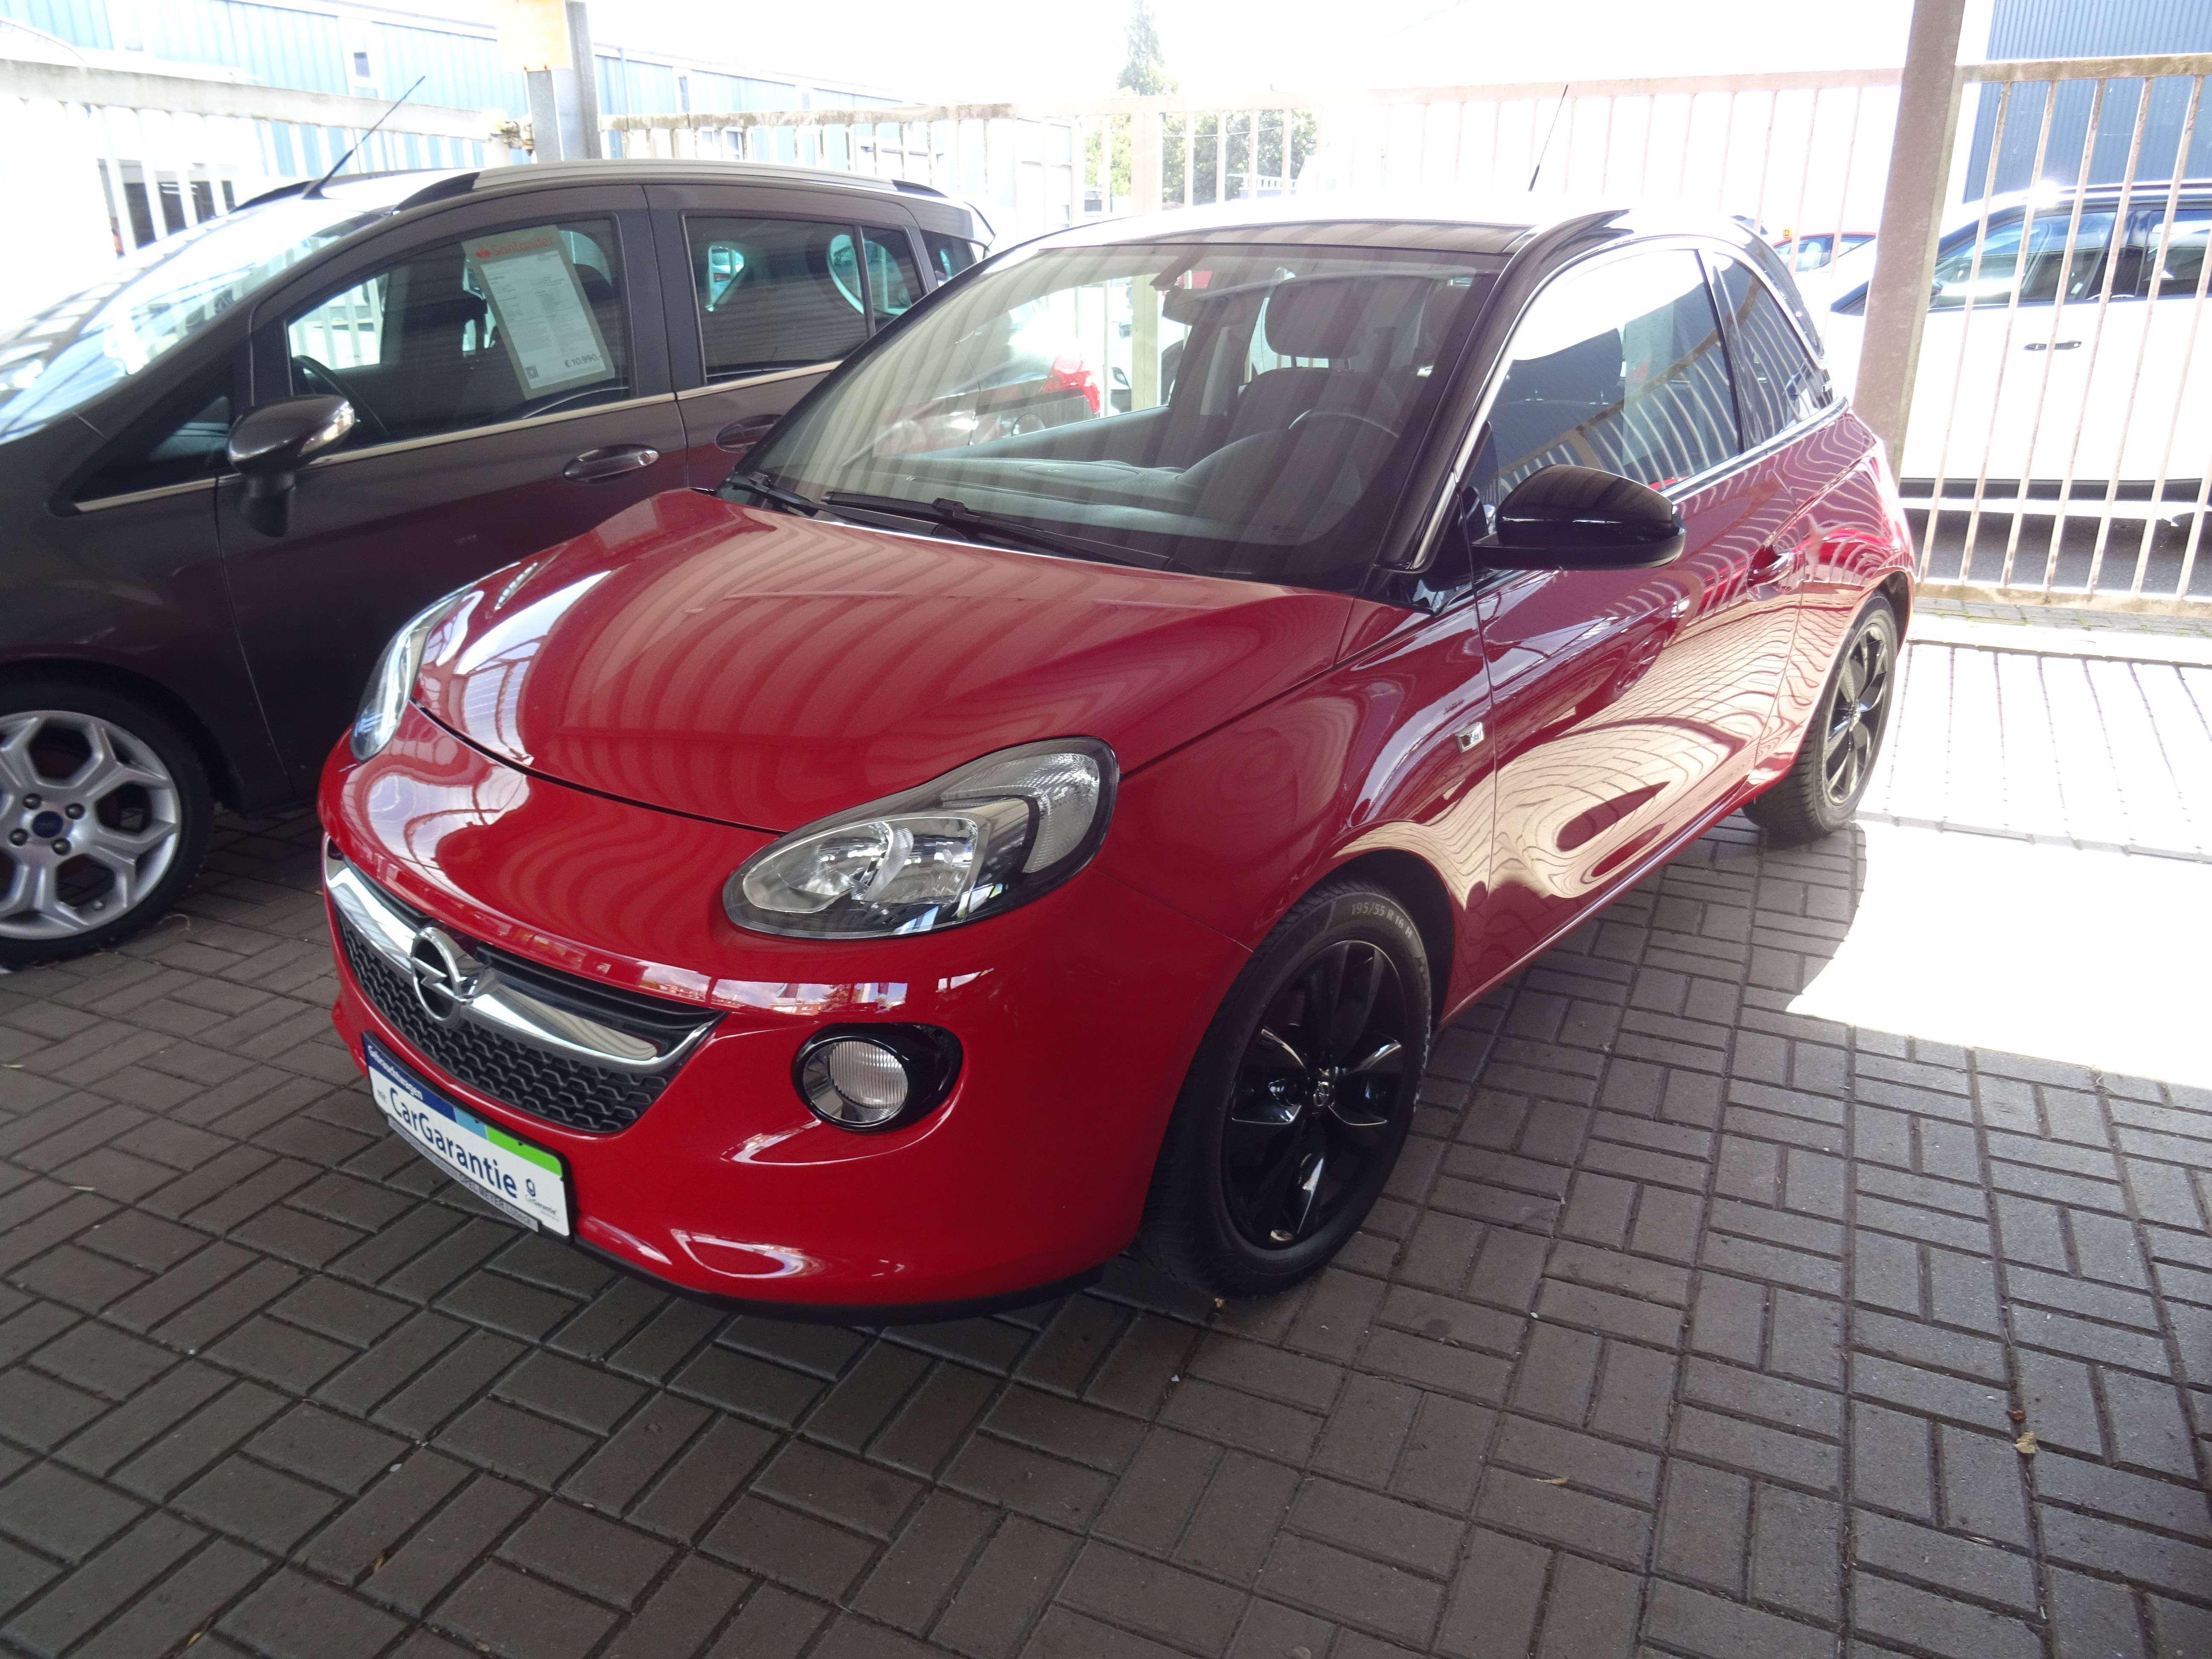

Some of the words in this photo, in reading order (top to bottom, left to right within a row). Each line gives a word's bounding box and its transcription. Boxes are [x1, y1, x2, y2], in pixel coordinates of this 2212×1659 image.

[491, 237, 552, 255] Santander
[1351, 902, 1385, 916] 195/55
[1387, 909, 1394, 920] R
[1394, 916, 1404, 928] 16
[390, 1087, 518, 1199] CarGarantie
